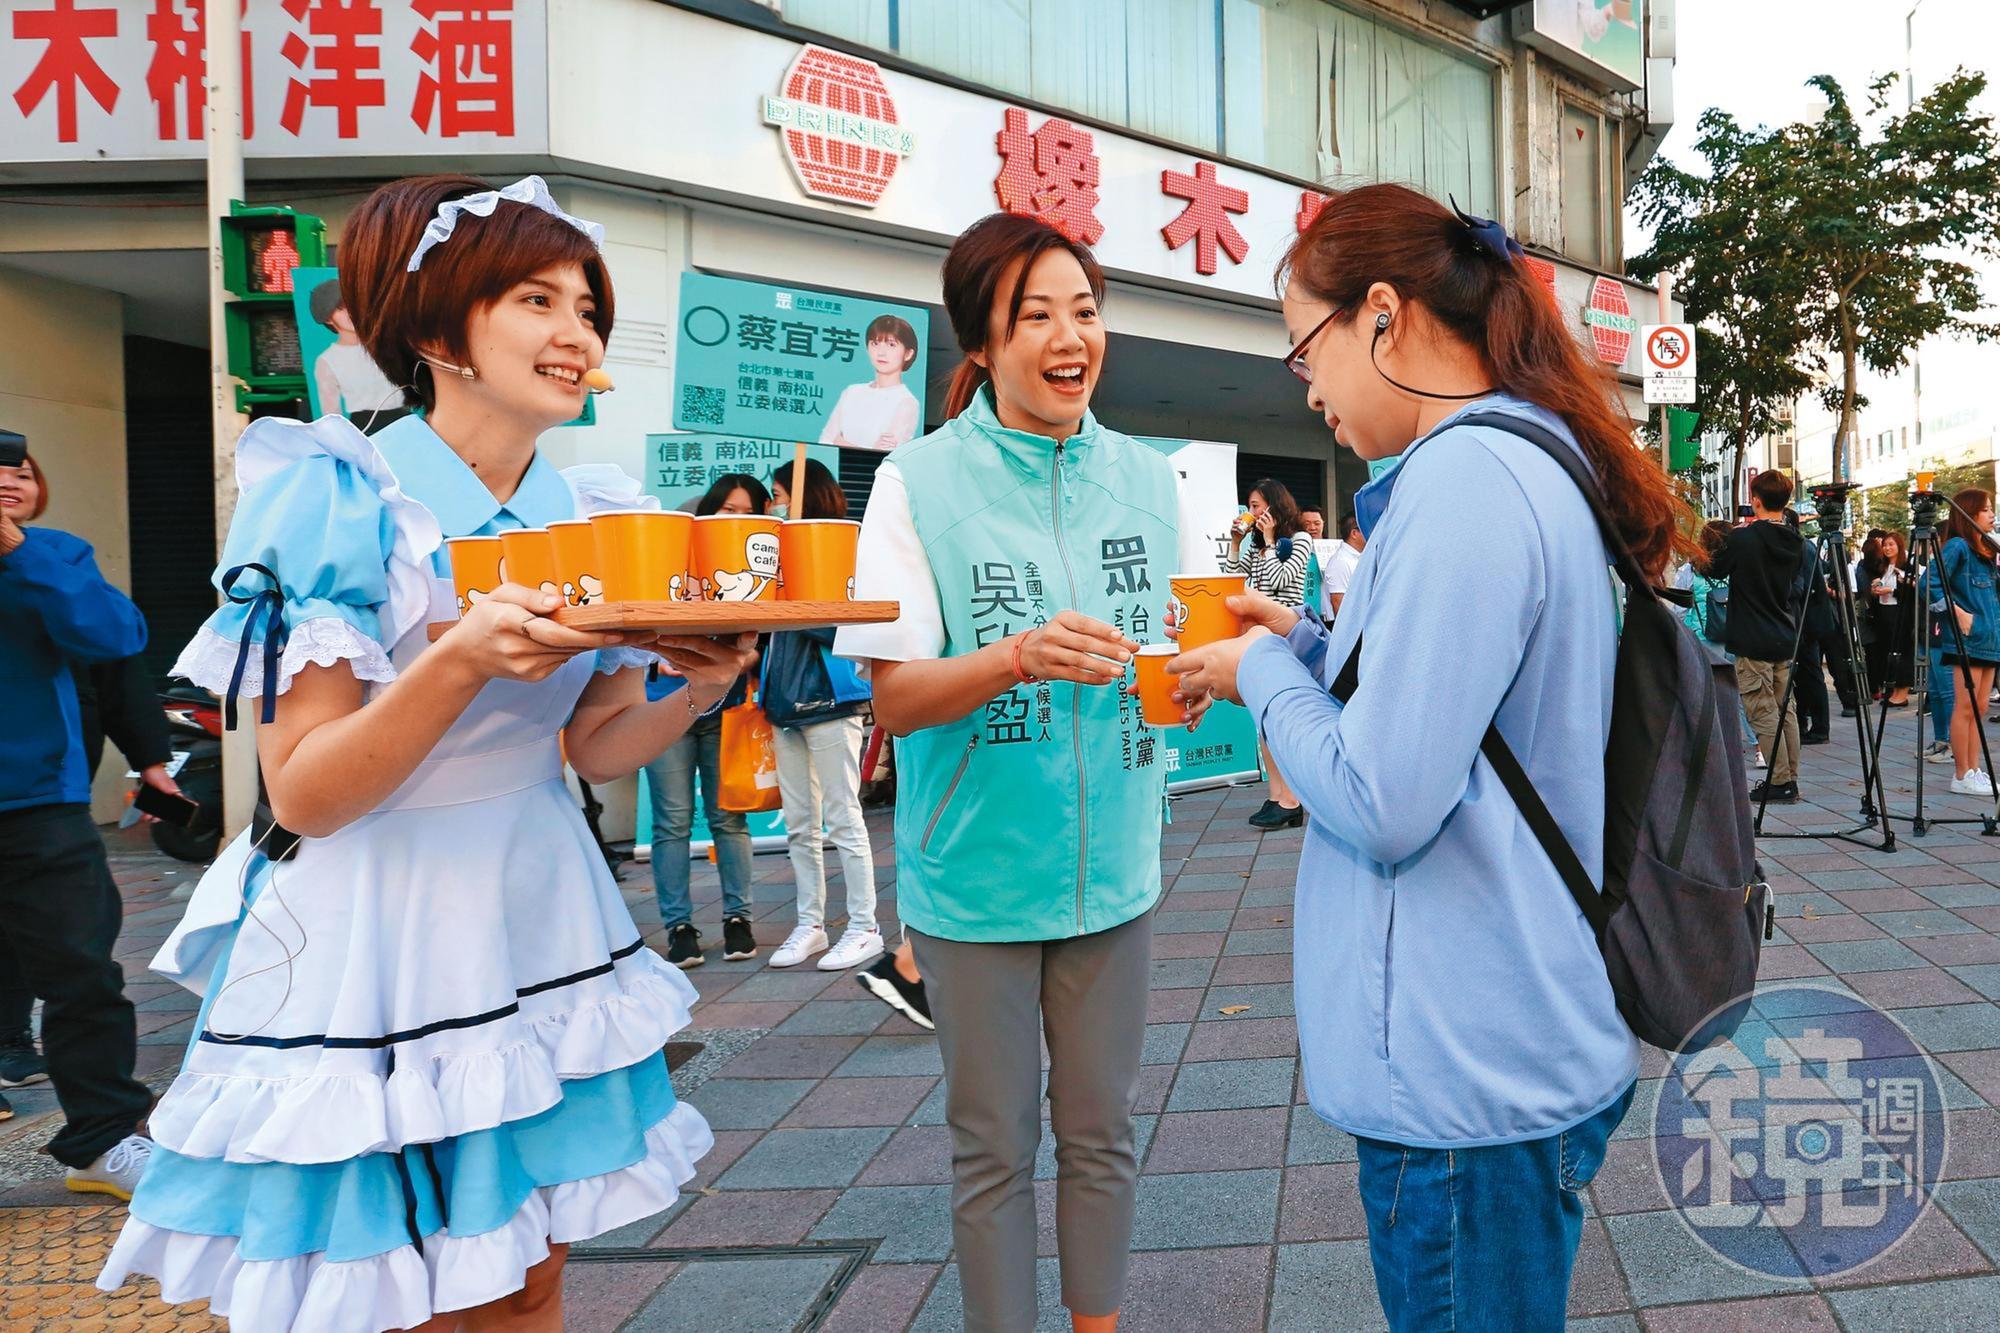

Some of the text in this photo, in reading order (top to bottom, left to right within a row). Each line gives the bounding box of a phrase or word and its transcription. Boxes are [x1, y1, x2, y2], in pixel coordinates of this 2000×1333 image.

[766, 97, 914, 152] DRINKS
[737, 314, 861, 363] 蔡宜芳
[1657, 336, 1680, 360] 停
[738, 376, 824, 399] 信義 南松山
[736, 393, 822, 416] 立委候選人
[658, 440, 781, 462] 信義 南松山
[1101, 535, 1151, 597] 眾
[1122, 730, 1132, 771] PARTY
